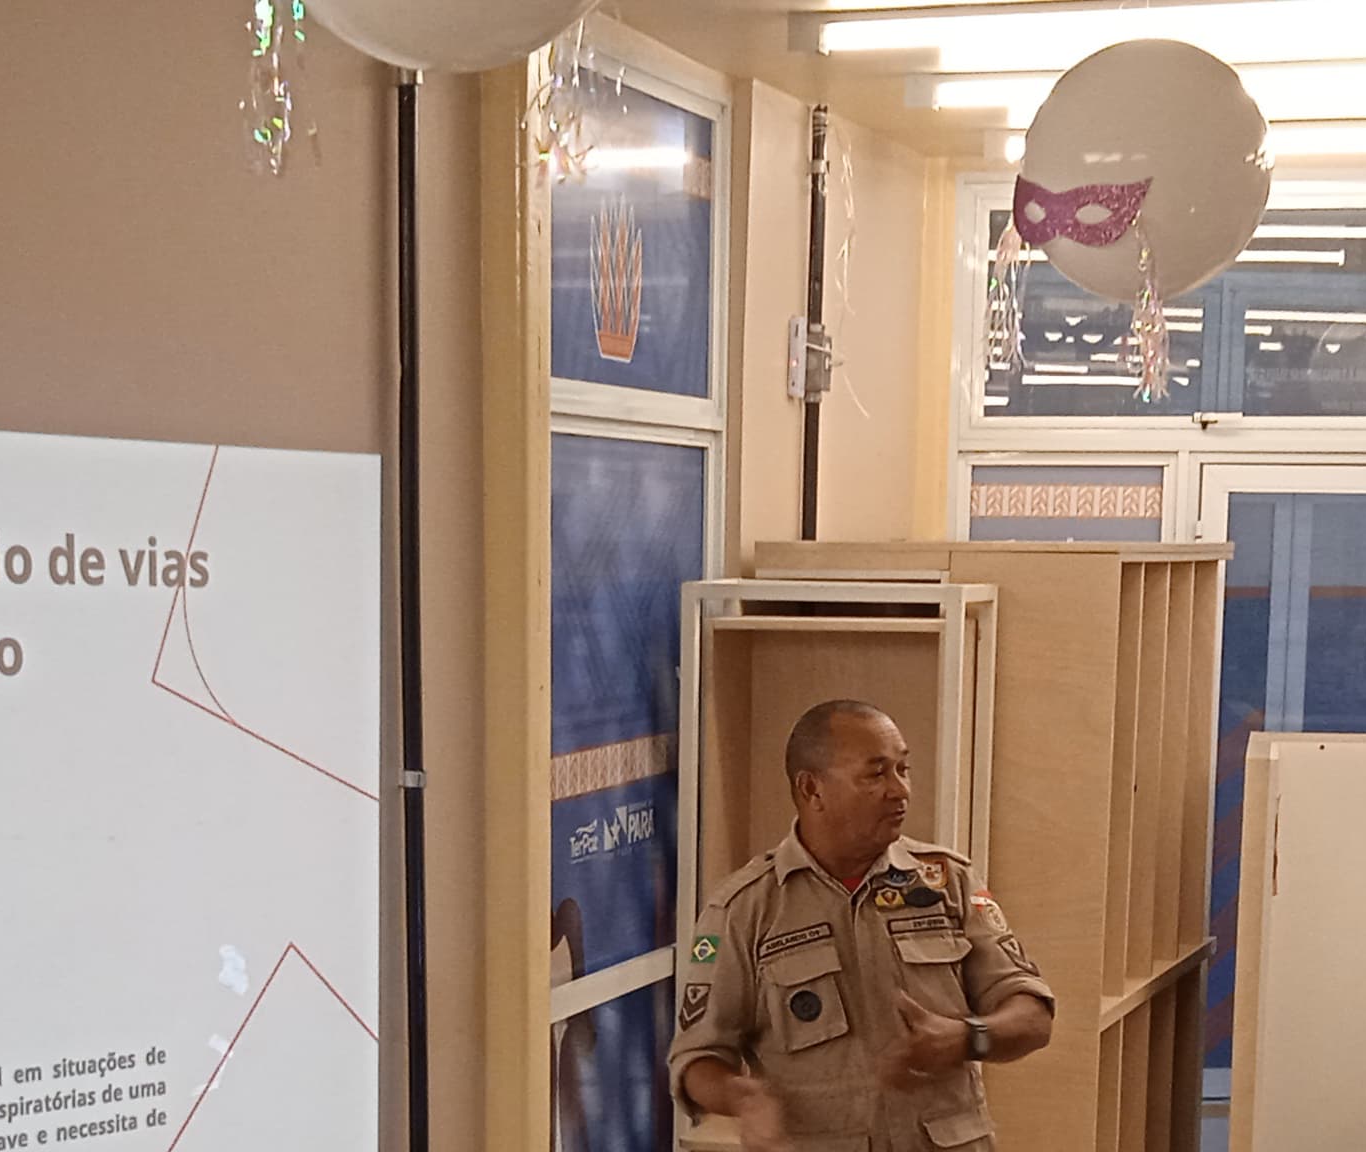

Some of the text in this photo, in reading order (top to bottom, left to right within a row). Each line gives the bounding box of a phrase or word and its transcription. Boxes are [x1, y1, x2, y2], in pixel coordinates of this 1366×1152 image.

[48, 533, 106, 587] de
[119, 536, 210, 589] vias
[13, 1063, 43, 1084] em
[52, 1050, 136, 1079] situações
[145, 1046, 167, 1066] de
[101, 1083, 124, 1105] de
[128, 1078, 167, 1100] uma
[36, 1127, 48, 1145] e
[55, 1113, 138, 1143] necessita
[145, 1107, 168, 1130] de
